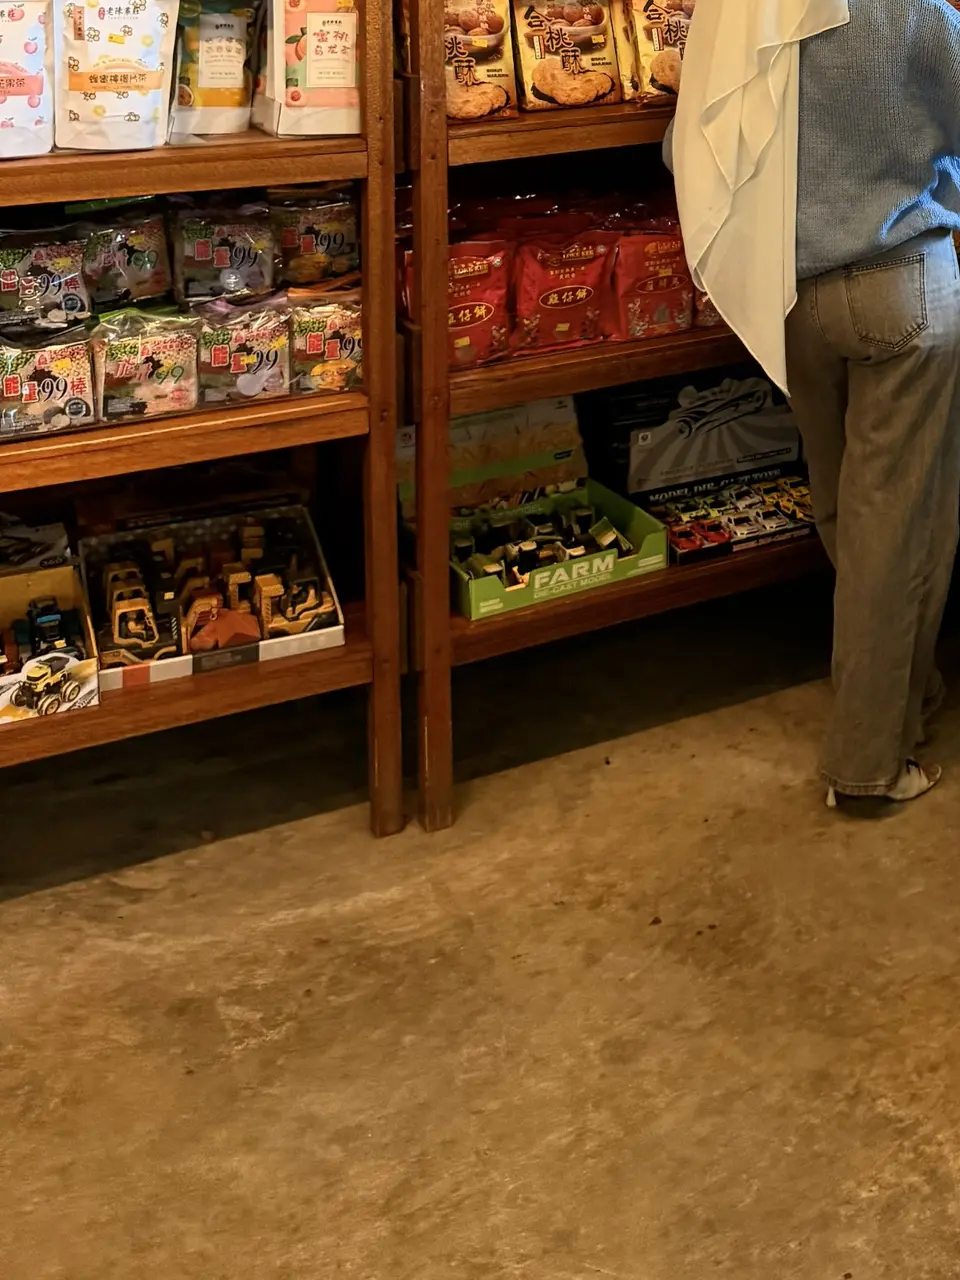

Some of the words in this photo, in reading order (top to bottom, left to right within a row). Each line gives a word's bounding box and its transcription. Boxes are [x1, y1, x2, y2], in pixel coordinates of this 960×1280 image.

[650, 487, 692, 503] MODEL
[534, 554, 616, 589] FARM
[534, 579, 579, 599] DIE-CAST
[580, 572, 613, 586] MODEL
